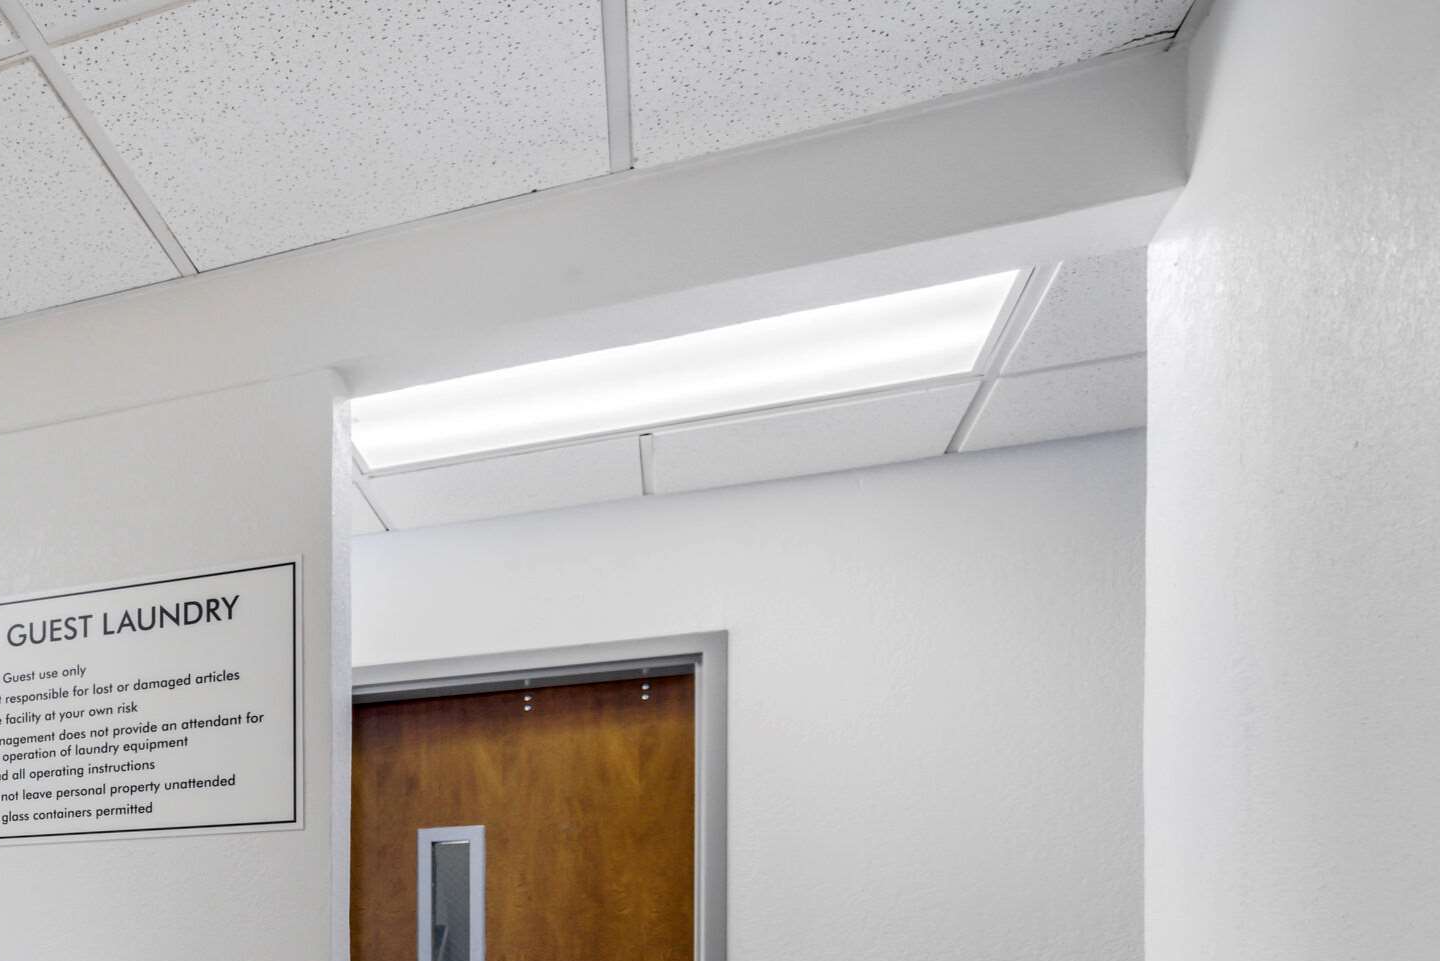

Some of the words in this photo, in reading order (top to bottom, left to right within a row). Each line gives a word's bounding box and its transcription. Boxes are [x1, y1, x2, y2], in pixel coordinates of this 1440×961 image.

[7, 614, 94, 648] GUEST
[102, 594, 240, 636] LAUNDRY
[2, 670, 36, 684] Guest
[38, 670, 59, 680] use
[61, 665, 87, 679] only
[5, 687, 70, 705] responsible
[72, 685, 90, 697] for
[92, 682, 114, 695] lost
[116, 683, 130, 693] or
[132, 673, 192, 691] damaged
[194, 669, 241, 685] articles
[4, 711, 42, 726] facility
[44, 710, 57, 722] at
[58, 709, 86, 723] your
[88, 706, 114, 717] own
[116, 700, 139, 715] risk
[58, 728, 87, 742] does
[89, 726, 110, 738] not
[112, 721, 158, 739] provide
[162, 722, 178, 732] an
[180, 713, 243, 731] attendant
[245, 712, 265, 725] for
[1, 747, 57, 765] operation
[59, 744, 73, 758] of
[74, 741, 121, 756] laundry
[122, 735, 189, 754] equipment
[11, 767, 26, 781] all
[28, 764, 85, 782] operating
[87, 759, 156, 775] instructions
[0, 790, 19, 802] not
[22, 788, 53, 801] leave
[55, 783, 107, 801] personal
[109, 781, 161, 798] property
[164, 774, 237, 791] unattended
[0, 810, 30, 825] glass
[32, 807, 93, 821] containers
[96, 801, 153, 820] permitted
